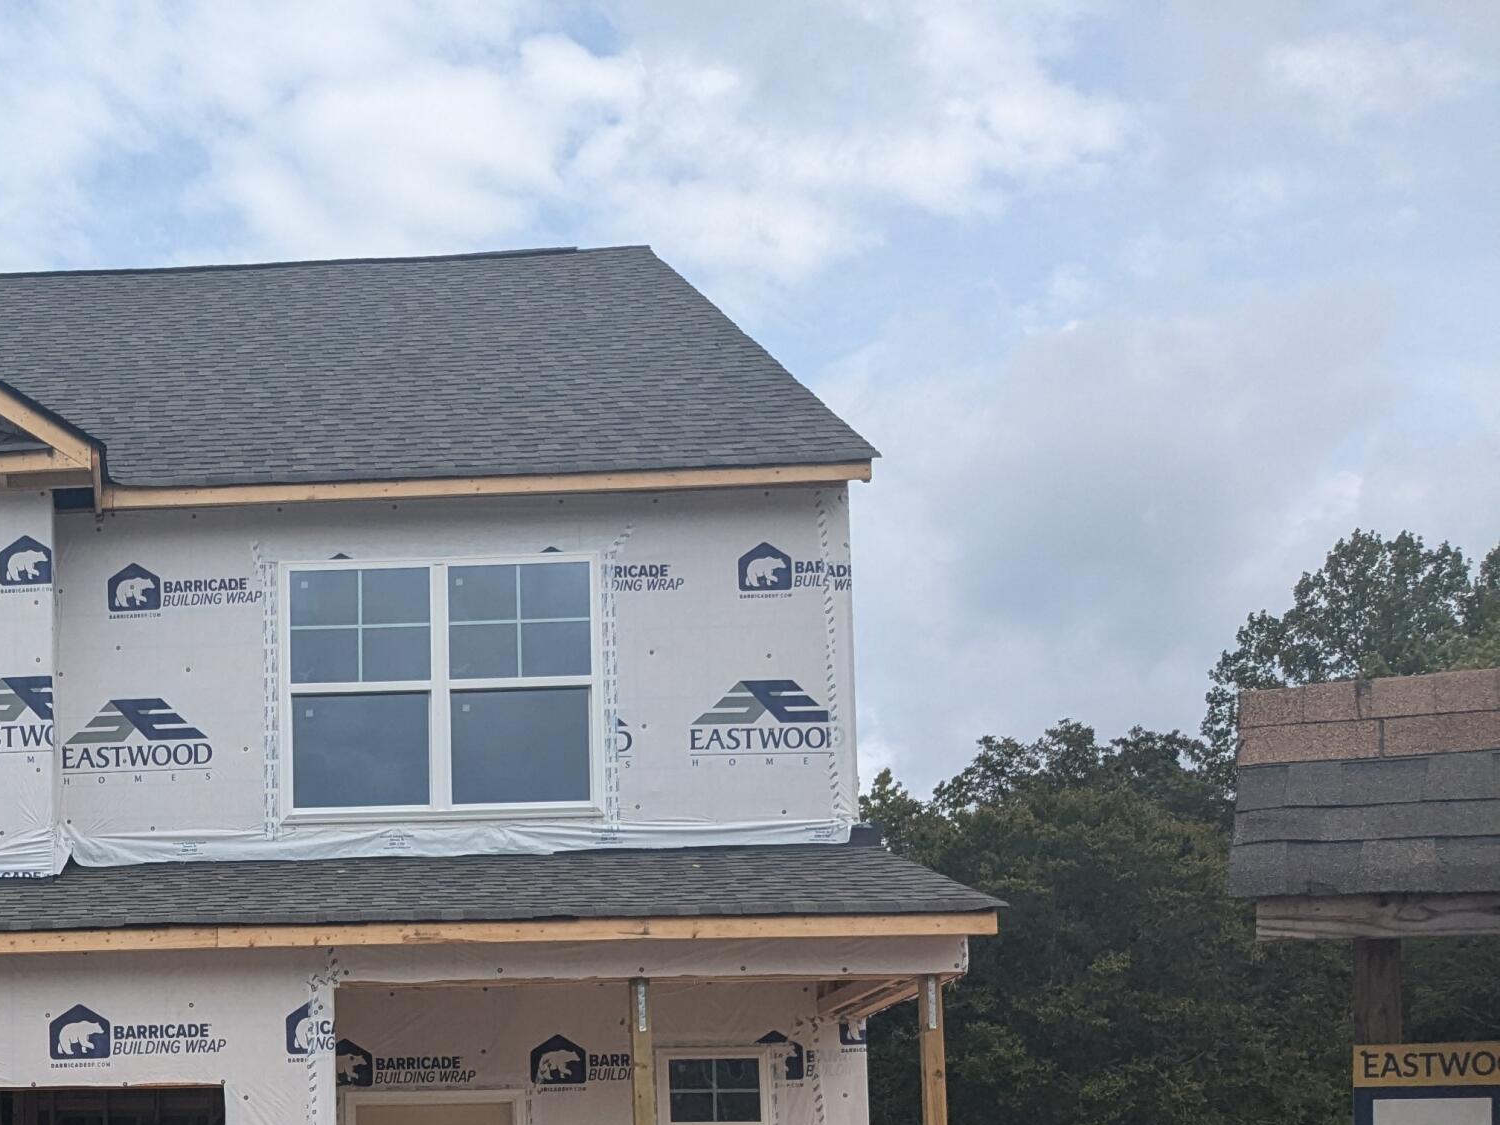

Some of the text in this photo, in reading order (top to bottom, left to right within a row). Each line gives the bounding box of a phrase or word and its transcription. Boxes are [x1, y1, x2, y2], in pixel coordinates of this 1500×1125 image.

[163, 577, 248, 594] BARRICADE
[646, 578, 685, 591] WRAP
[162, 591, 262, 607] BUILDING WRAP
[62, 743, 213, 769] EASTWOOD
[113, 1023, 211, 1040] BARRICADE
[112, 1039, 227, 1056] BUILDING WRAP
[376, 1056, 462, 1070] BARRICADE
[1363, 1050, 1500, 1079] EASTWO
[375, 1070, 476, 1084] BUILDING WRAP
